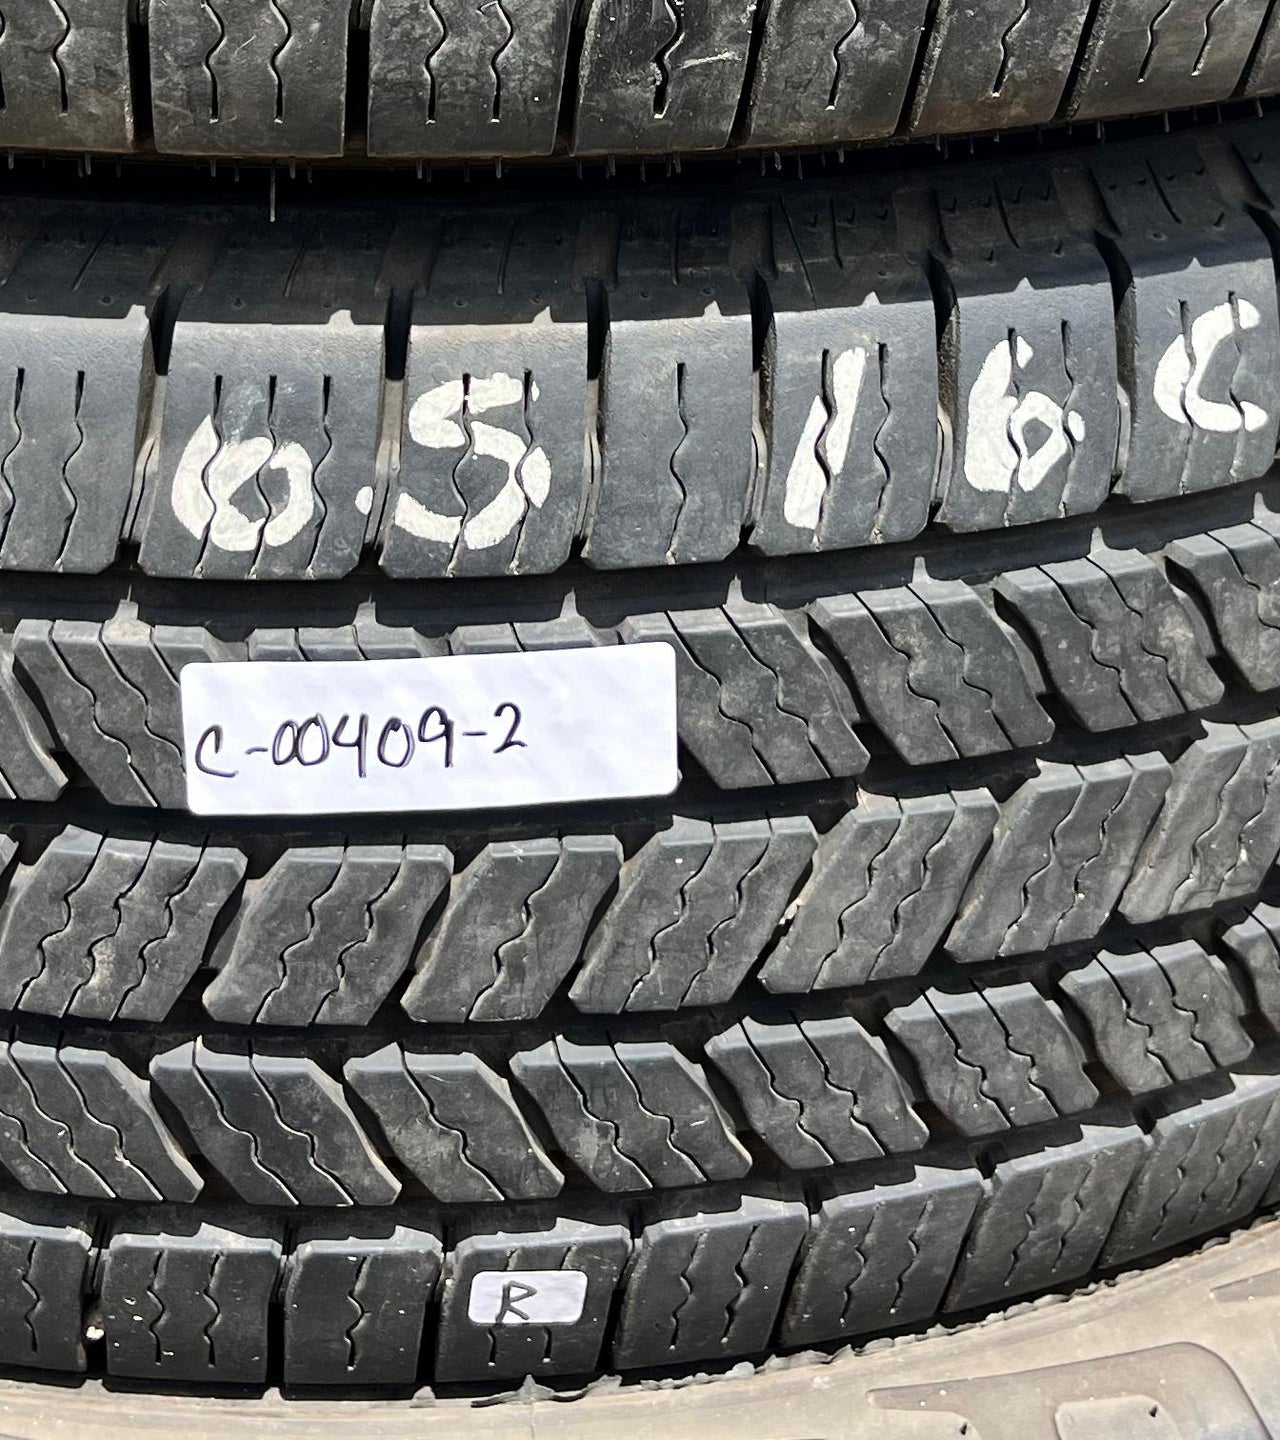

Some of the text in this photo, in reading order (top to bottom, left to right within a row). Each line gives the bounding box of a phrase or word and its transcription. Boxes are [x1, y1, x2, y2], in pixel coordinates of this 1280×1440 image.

[170, 371, 552, 552] 65
[194, 702, 528, 778] C-00409-2
[494, 1279, 538, 1327] R
